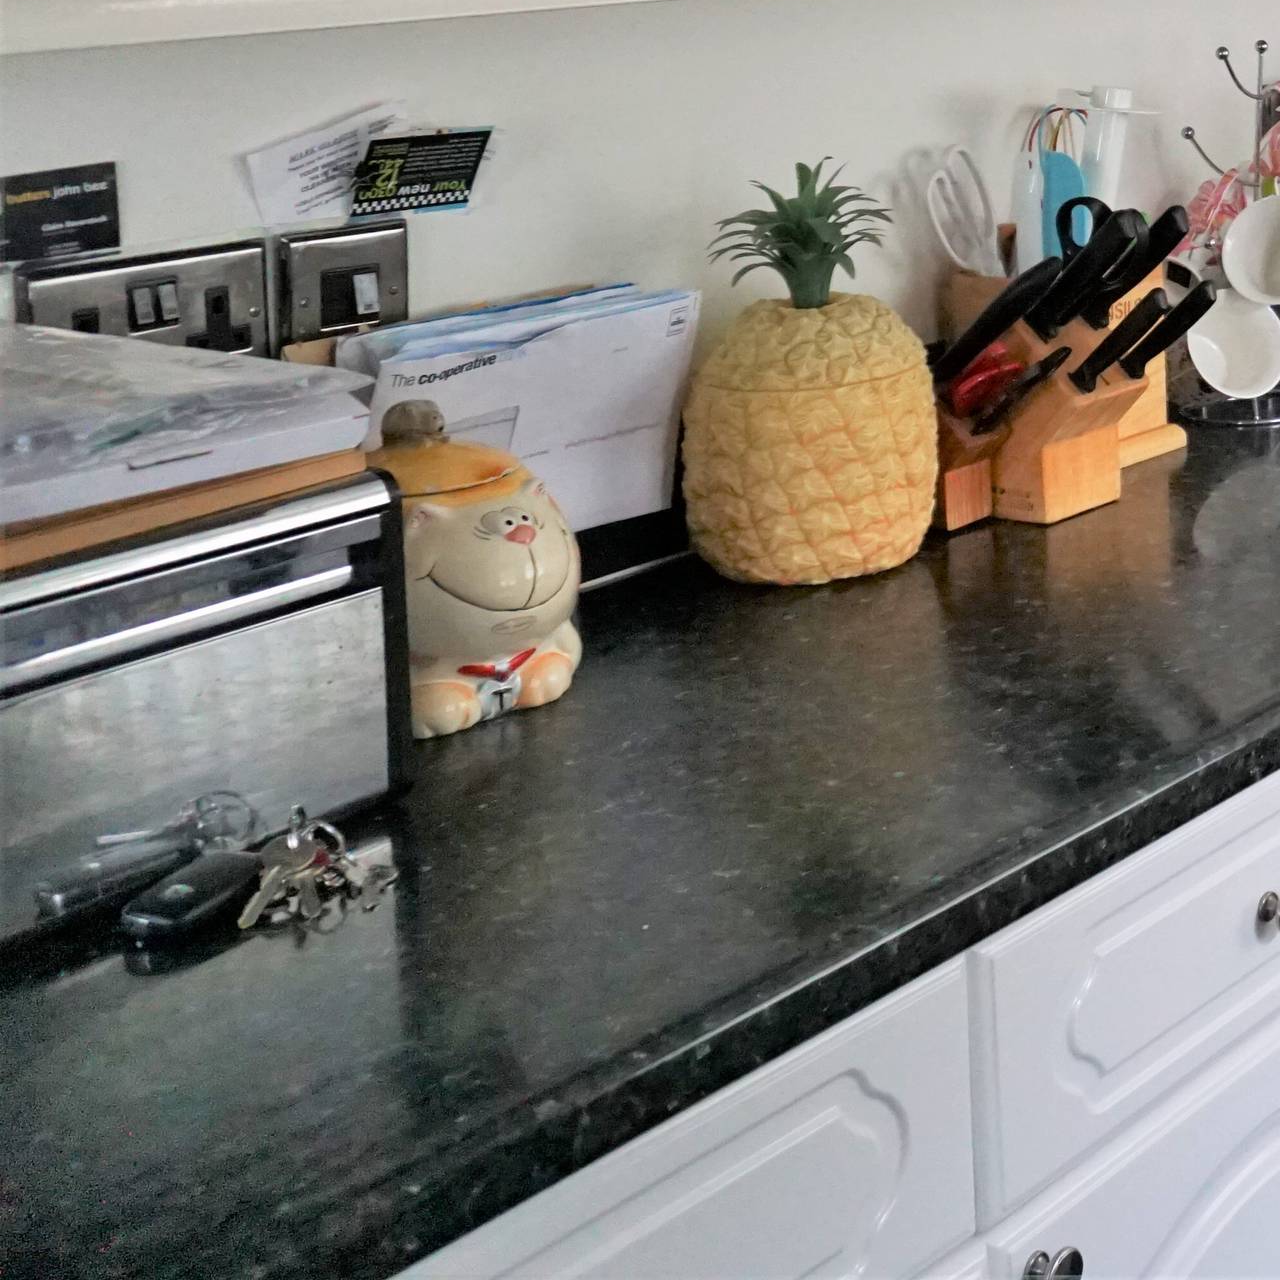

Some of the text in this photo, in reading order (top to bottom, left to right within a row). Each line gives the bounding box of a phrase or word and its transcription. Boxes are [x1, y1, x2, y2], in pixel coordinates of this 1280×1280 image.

[397, 182, 431, 196] new
[432, 179, 467, 193] Your
[391, 374, 415, 388] The
[418, 354, 497, 385] co-operative
[490, 687, 513, 711] T
